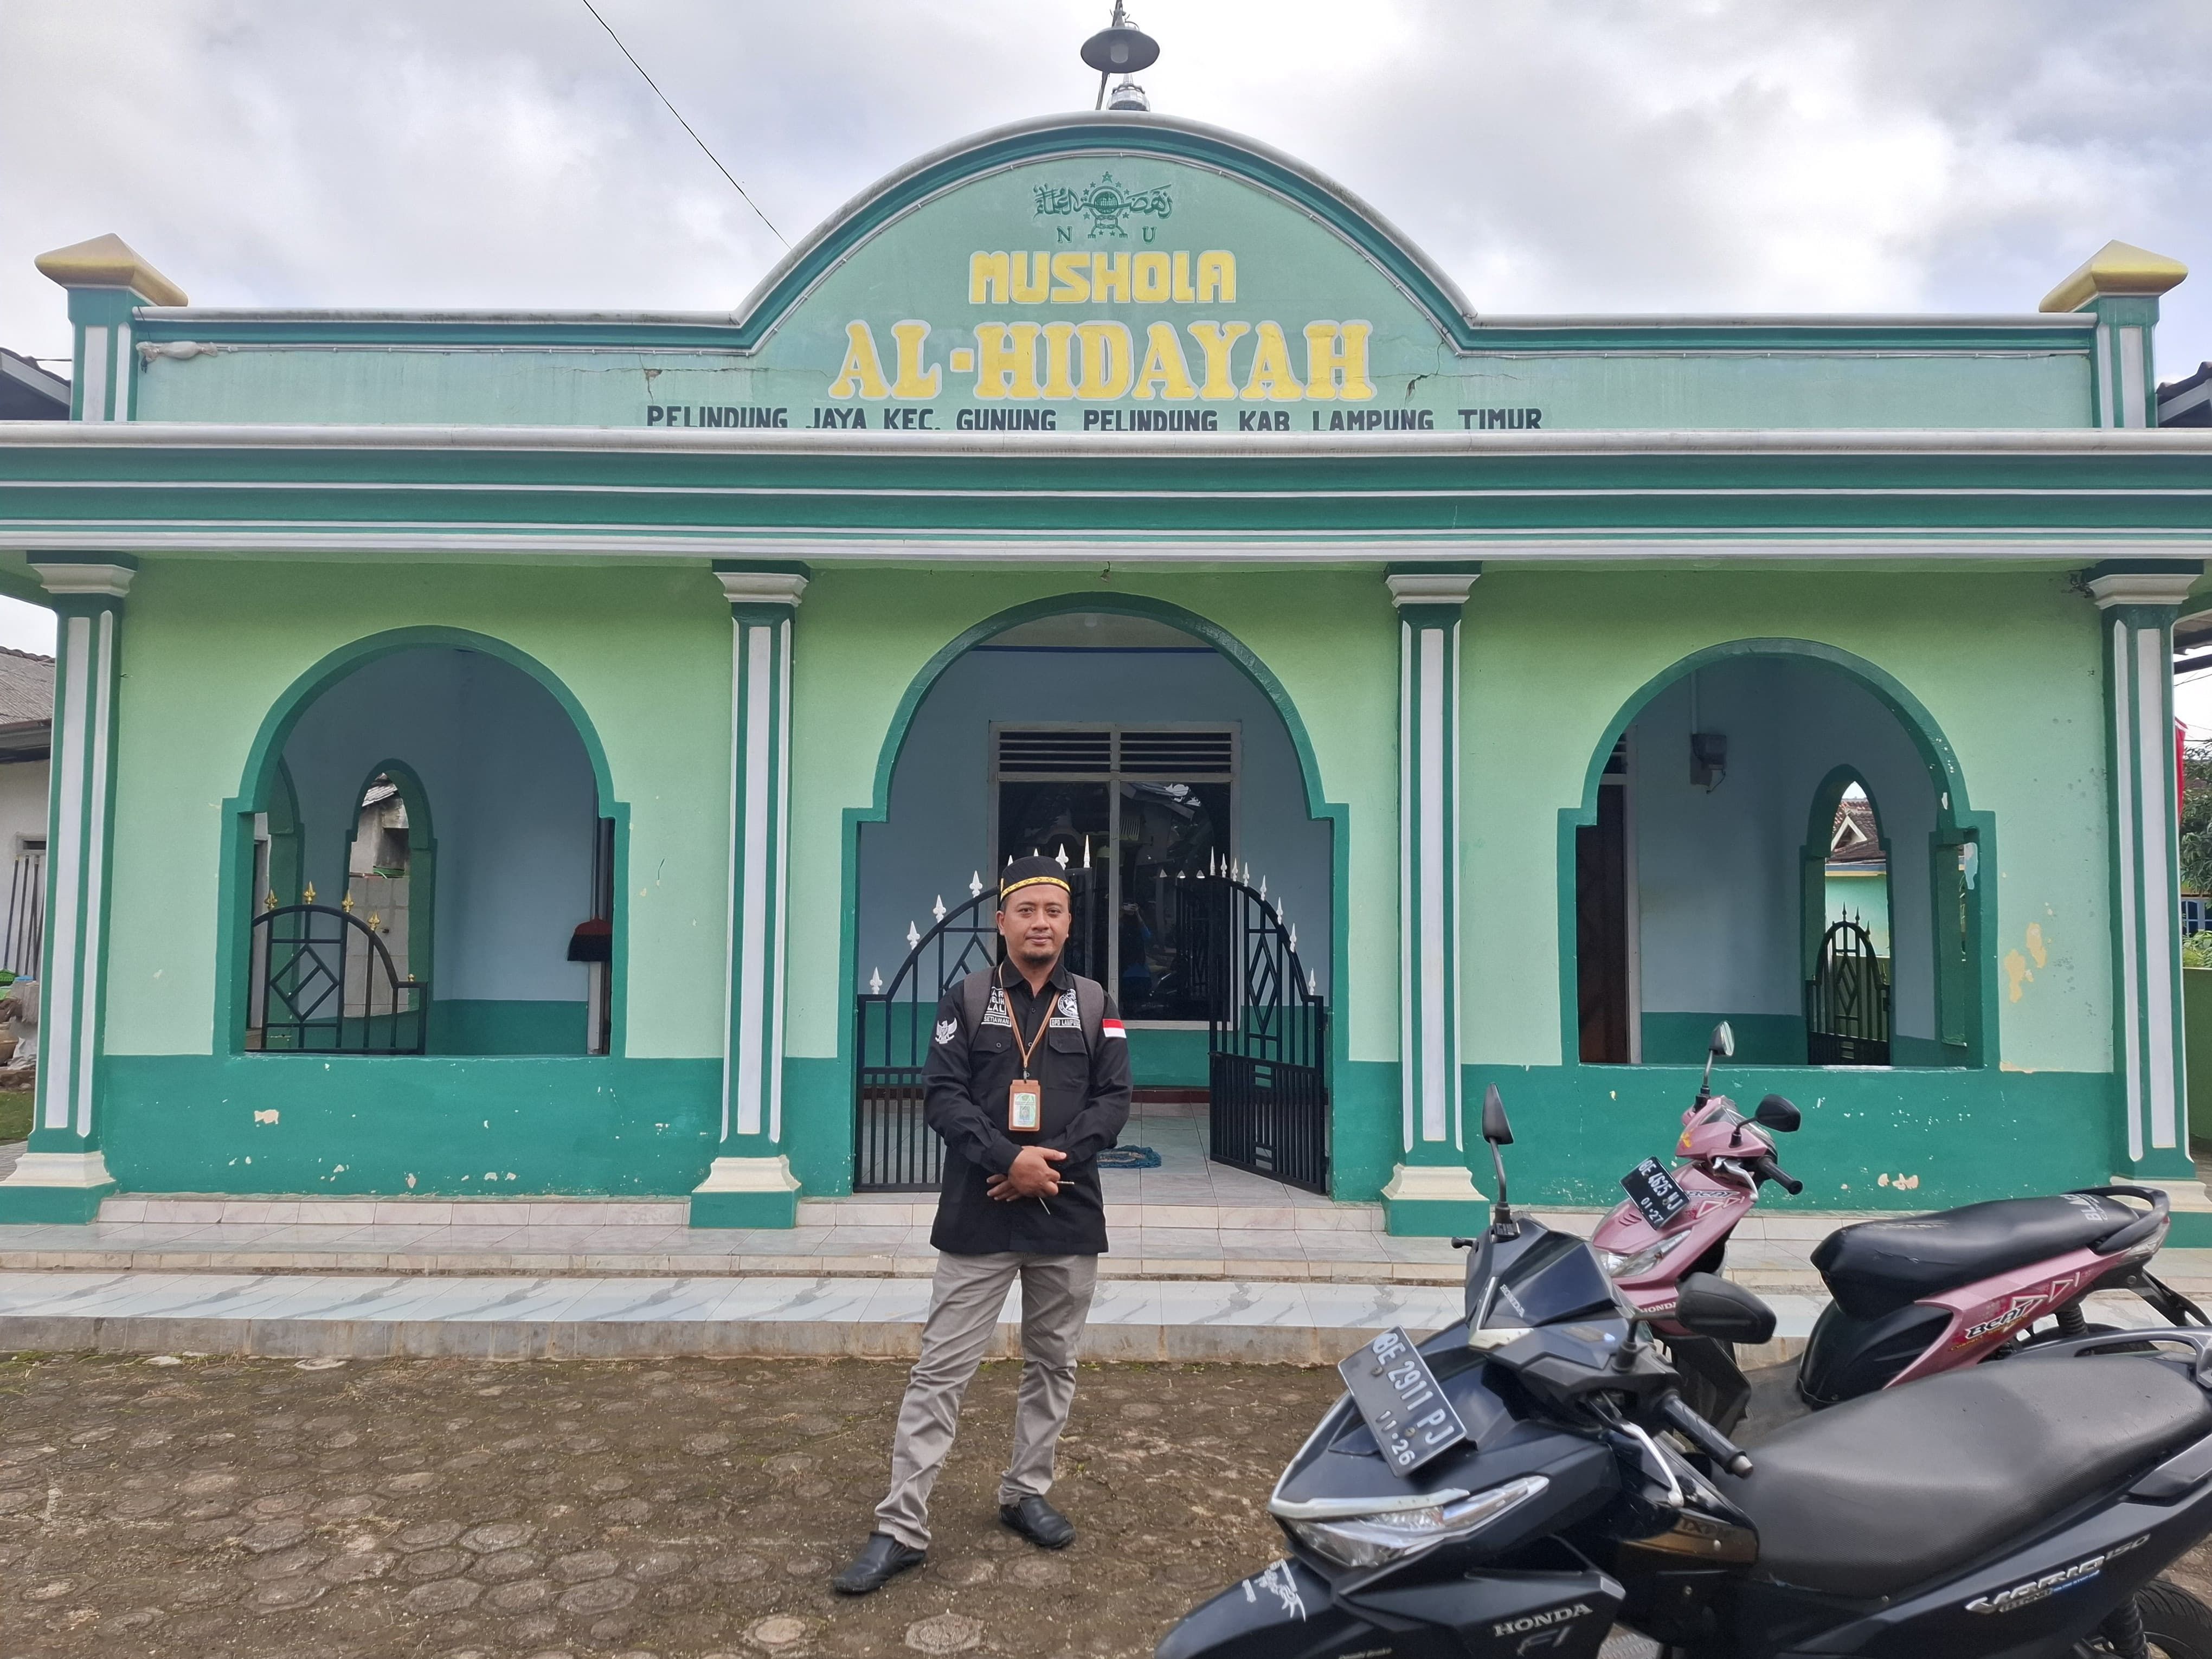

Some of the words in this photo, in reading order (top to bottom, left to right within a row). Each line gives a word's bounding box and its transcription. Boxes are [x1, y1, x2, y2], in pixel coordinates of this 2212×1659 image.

[1057, 226, 1073, 243] N
[1142, 226, 1158, 244] U
[969, 250, 1236, 304] MUSHOLA
[828, 319, 1377, 402] AL-HIDAYAH
[647, 405, 788, 428] PELINDUNG
[806, 408, 867, 429] JAYA
[883, 408, 941, 430] KEC.
[956, 408, 1056, 430] GUNUNG
[1084, 409, 1218, 431] PELINDUNG
[1239, 410, 1290, 431] KAB
[1313, 409, 1434, 430] LAMPUNG
[1458, 408, 1542, 429] TIMUR
[983, 1016, 1009, 1025] SETIAWAN
[987, 1004, 1005, 1012] LAL
[1638, 1159, 1656, 1176] BE
[1372, 1332, 1406, 1365] BE
[1387, 1360, 1433, 1411] 2911
[1416, 1409, 1455, 1445] PJ
[1493, 1603, 1593, 1637] HONDA
